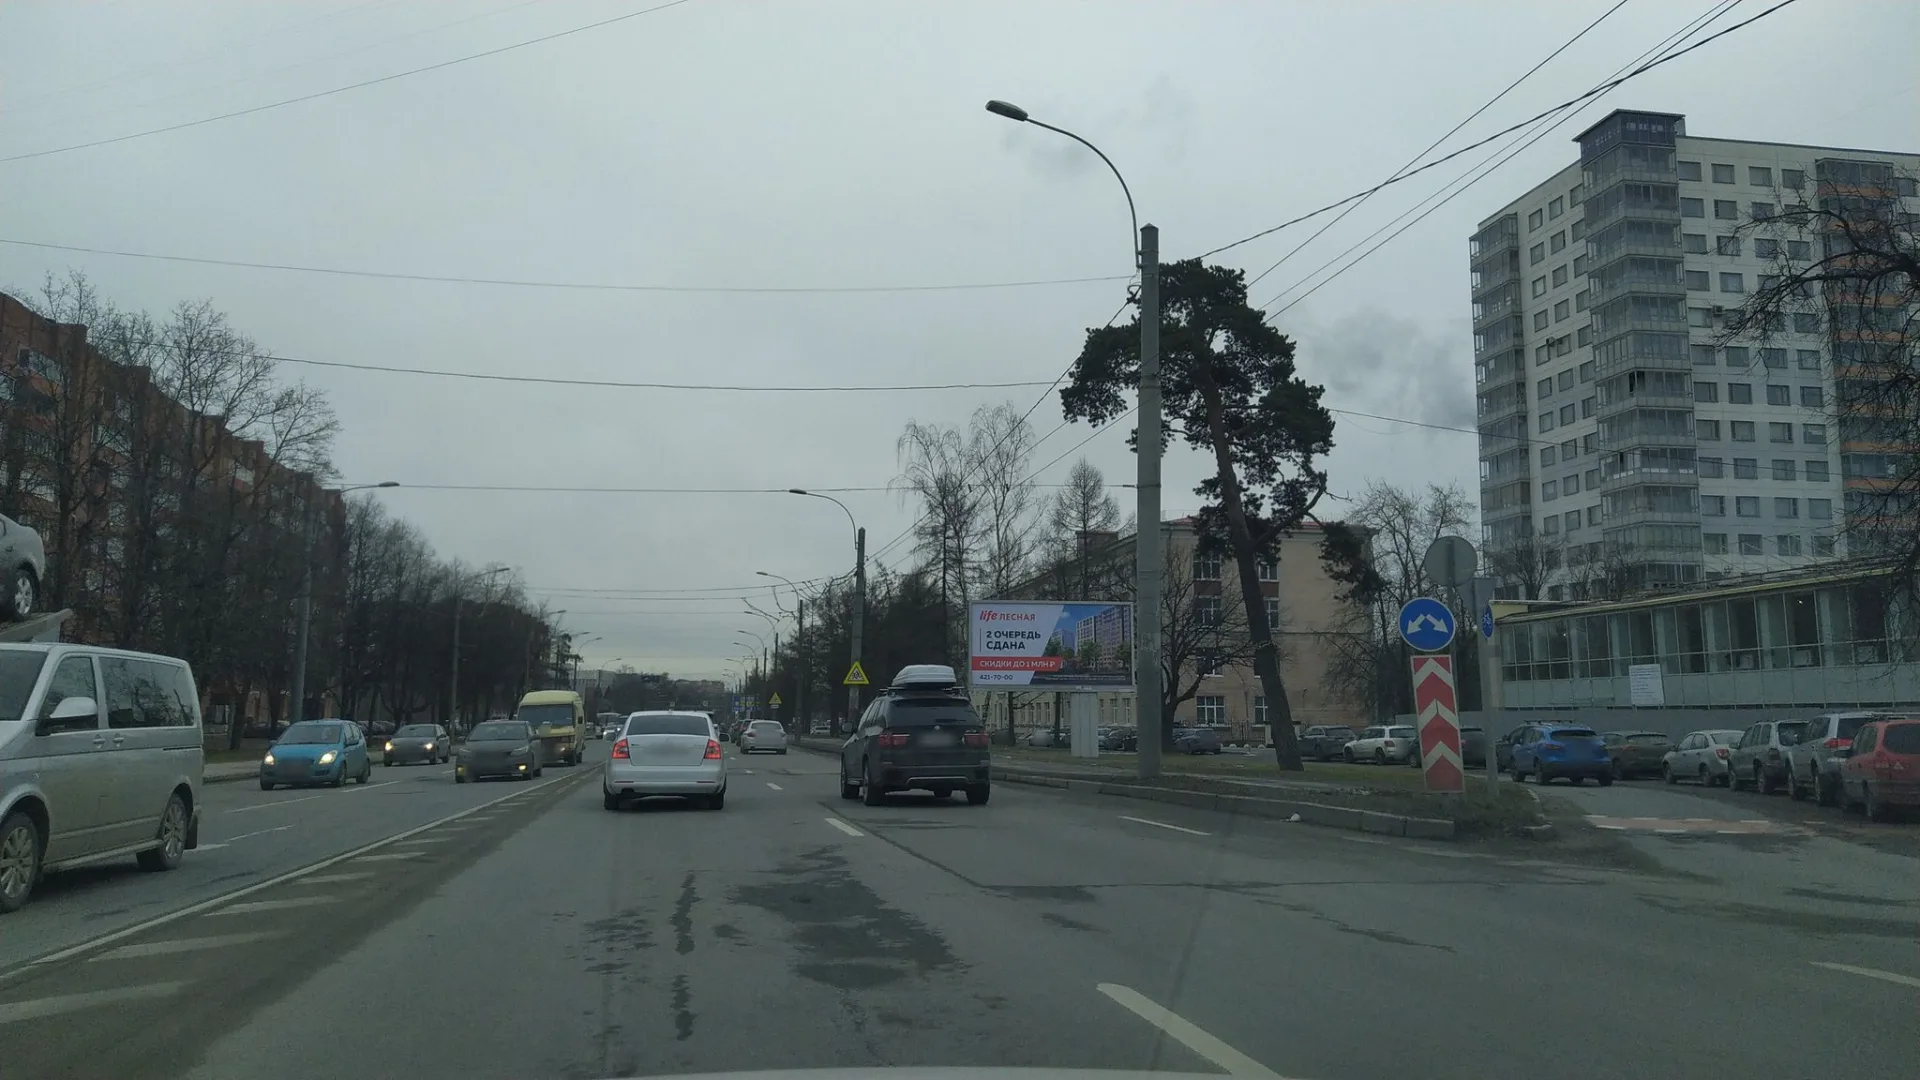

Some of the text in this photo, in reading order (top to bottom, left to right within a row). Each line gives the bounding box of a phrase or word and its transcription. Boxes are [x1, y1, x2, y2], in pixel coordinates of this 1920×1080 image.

[980, 610, 1036, 622] life ЛЕСНАЯ
[986, 630, 1041, 640] 2 ОЧЕРЕДЬ
[986, 641, 1025, 651] СДАНА
[980, 660, 1012, 669] СКИДКИ
[1013, 660, 1026, 669] ДО
[1031, 660, 1049, 668] МЛН
